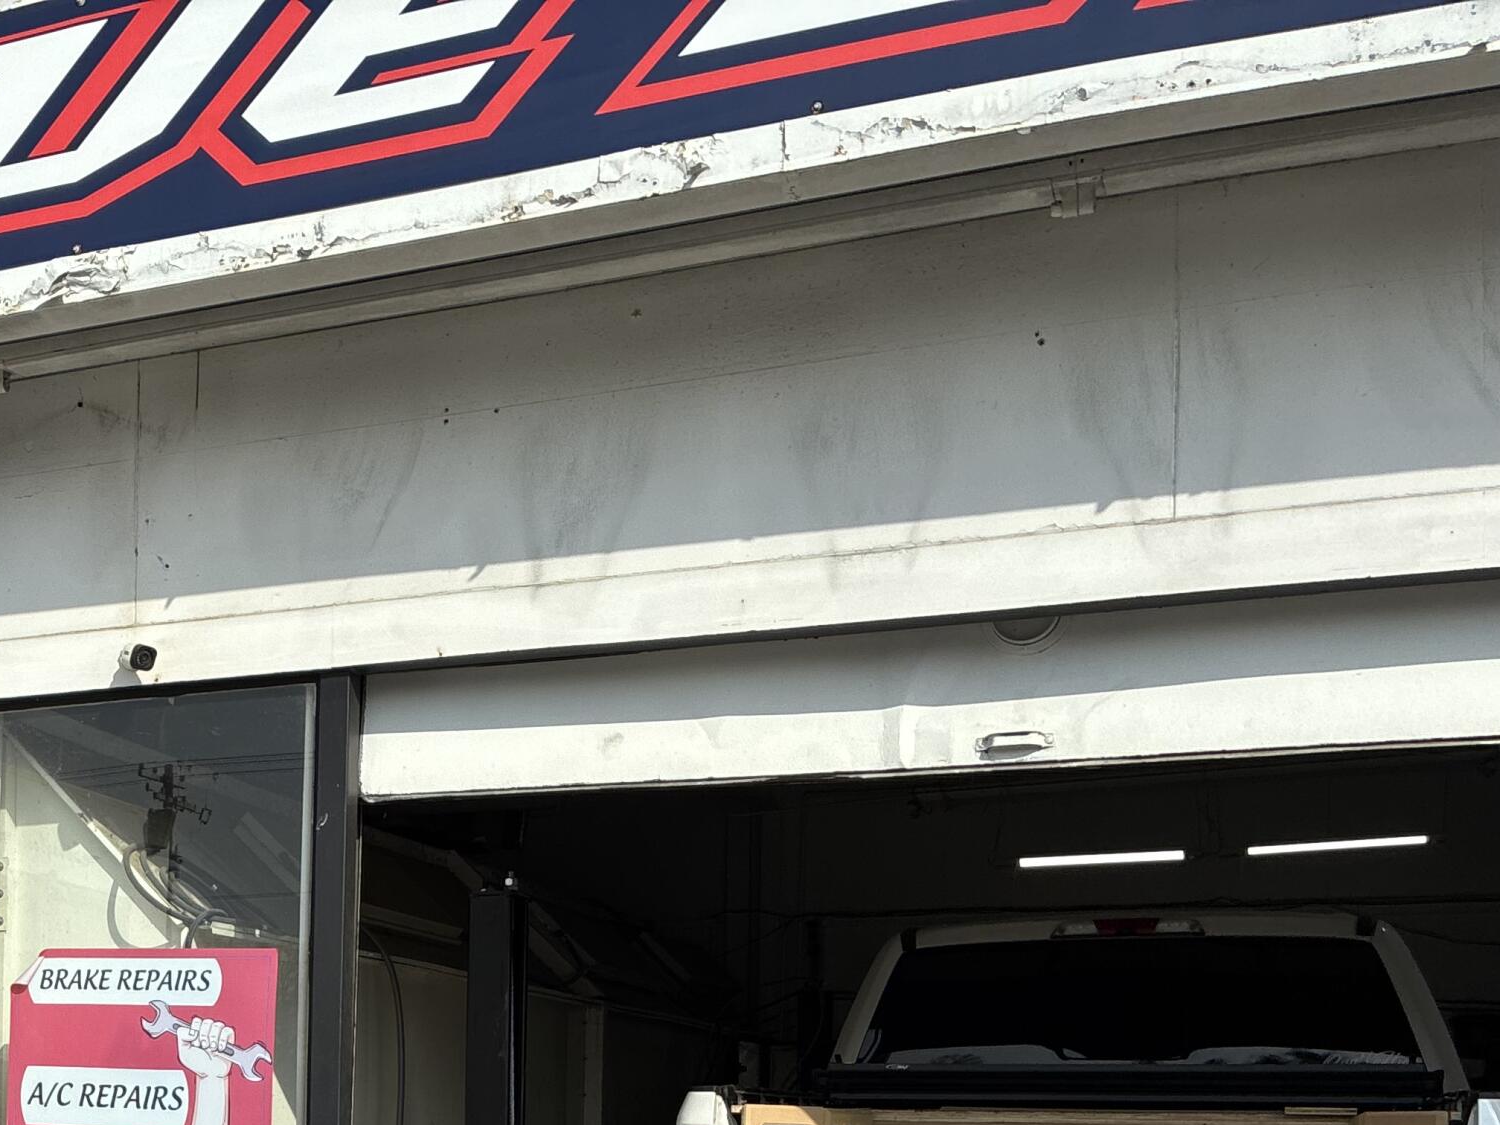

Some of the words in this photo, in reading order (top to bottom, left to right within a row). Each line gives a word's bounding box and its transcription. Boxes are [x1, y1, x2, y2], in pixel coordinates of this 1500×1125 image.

[39, 968, 112, 991] BRAKE
[117, 969, 212, 992] REPAIRS
[27, 1081, 74, 1107] A/C
[78, 1084, 185, 1111] REPAIRS
